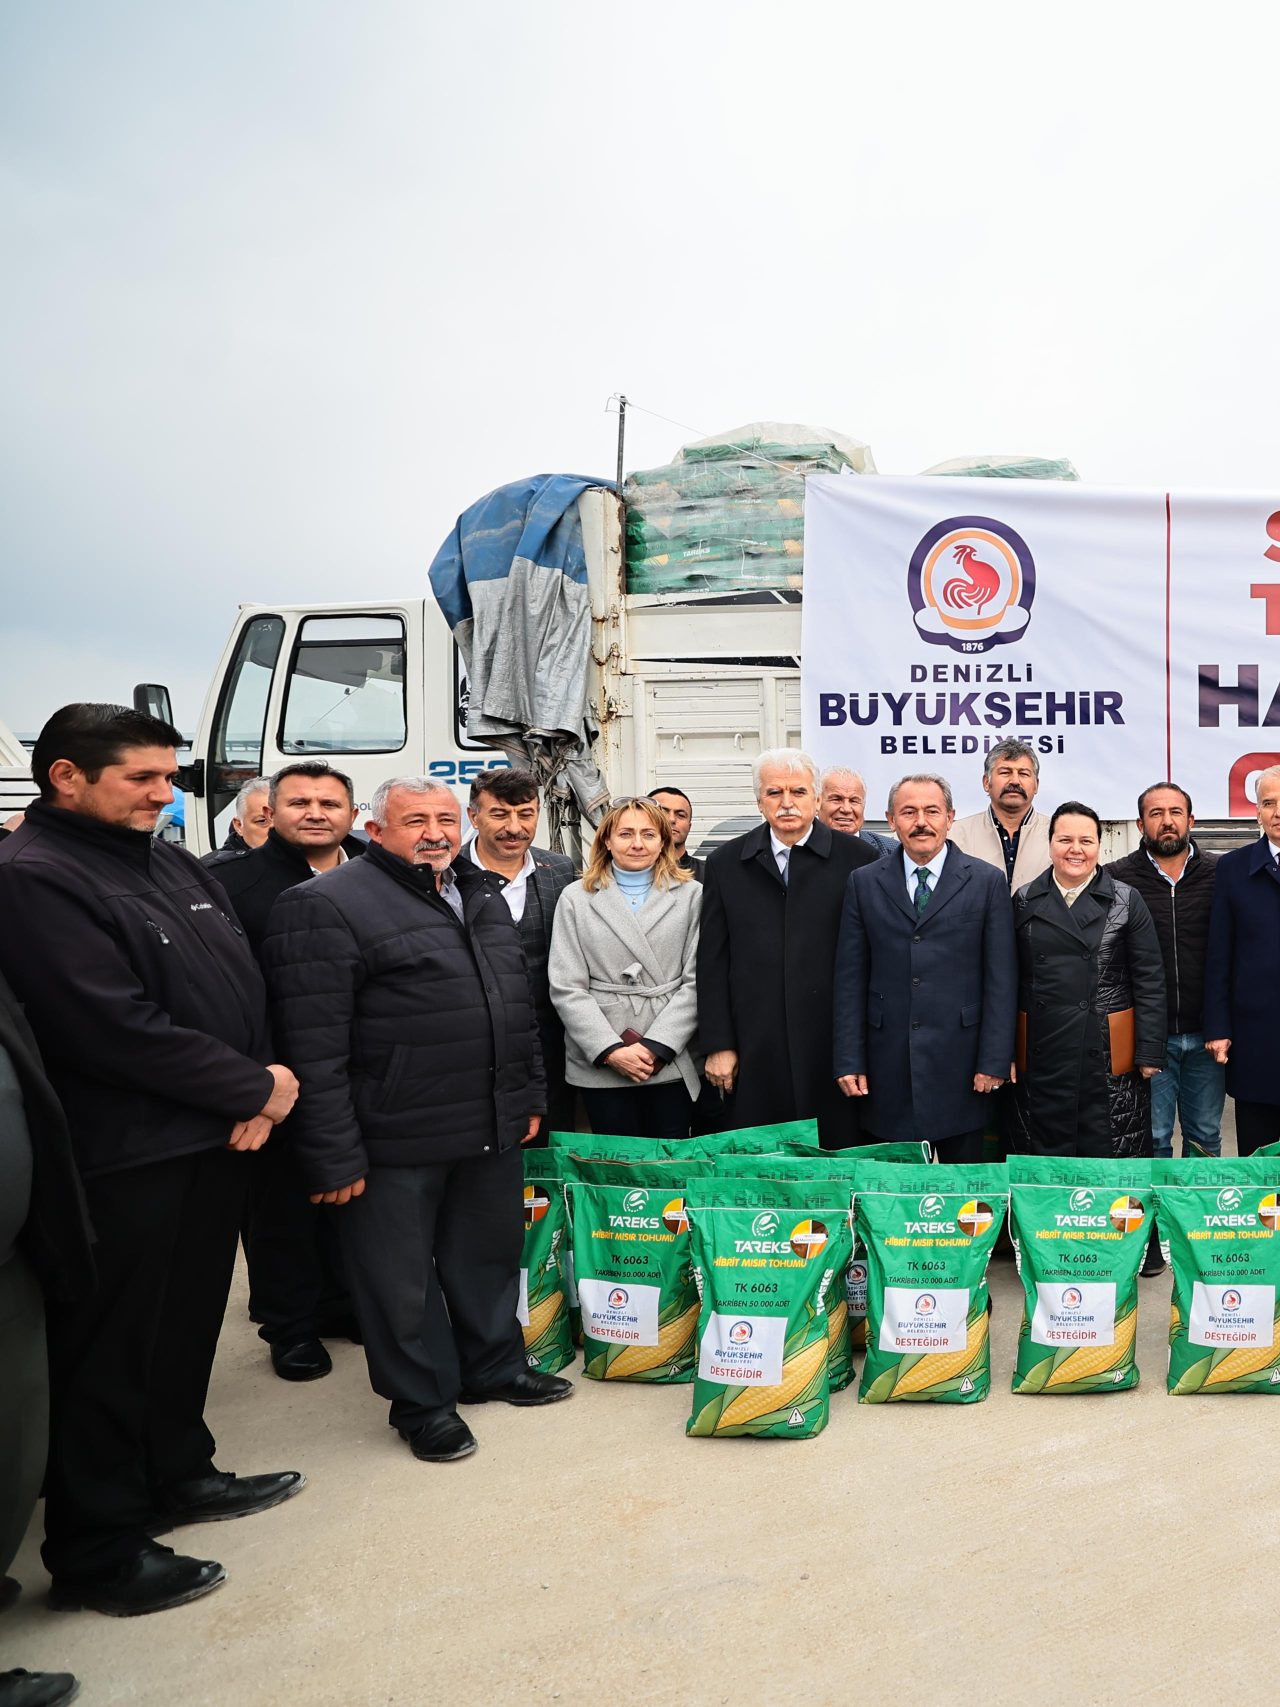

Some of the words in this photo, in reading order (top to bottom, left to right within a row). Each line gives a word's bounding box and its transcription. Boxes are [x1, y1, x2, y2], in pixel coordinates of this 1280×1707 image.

[961, 642, 984, 652] 1876
[910, 663, 1033, 683] DENİZLİ
[819, 691, 1125, 728] BÜYÜKŞEHİR
[608, 1216, 659, 1228] TAREKS
[1055, 1215, 1107, 1227] TAREKS
[1204, 1214, 1256, 1226] TAREKS
[904, 1222, 955, 1233] TAREKS
[615, 1232, 636, 1240] MISIR
[638, 1234, 675, 1242] TOHUMU
[1086, 1232, 1124, 1240] TOHUMU
[1238, 1231, 1274, 1239] TOHUMU
[735, 1241, 791, 1254] TAREKS
[611, 1255, 621, 1264] TK
[624, 1256, 648, 1264] 6063
[742, 1259, 767, 1267] MISIR
[769, 1260, 808, 1268] TOHUMU
[1059, 1254, 1070, 1263] TK
[1073, 1254, 1097, 1263] 6063
[1211, 1254, 1223, 1263] TK
[1226, 1254, 1249, 1263] 6063
[907, 1262, 919, 1270] TK
[922, 1262, 946, 1270] 6063
[735, 1283, 748, 1293] TK
[751, 1283, 778, 1293] 6063
[591, 1326, 639, 1340] DESTEĞİDİR
[1046, 1330, 1097, 1339] DESTEĞİDİR
[1204, 1332, 1256, 1341] DESTEĞİDİR
[896, 1337, 949, 1346] DESTEĞİDİR
[710, 1365, 762, 1379] DESTEĞİDİR
